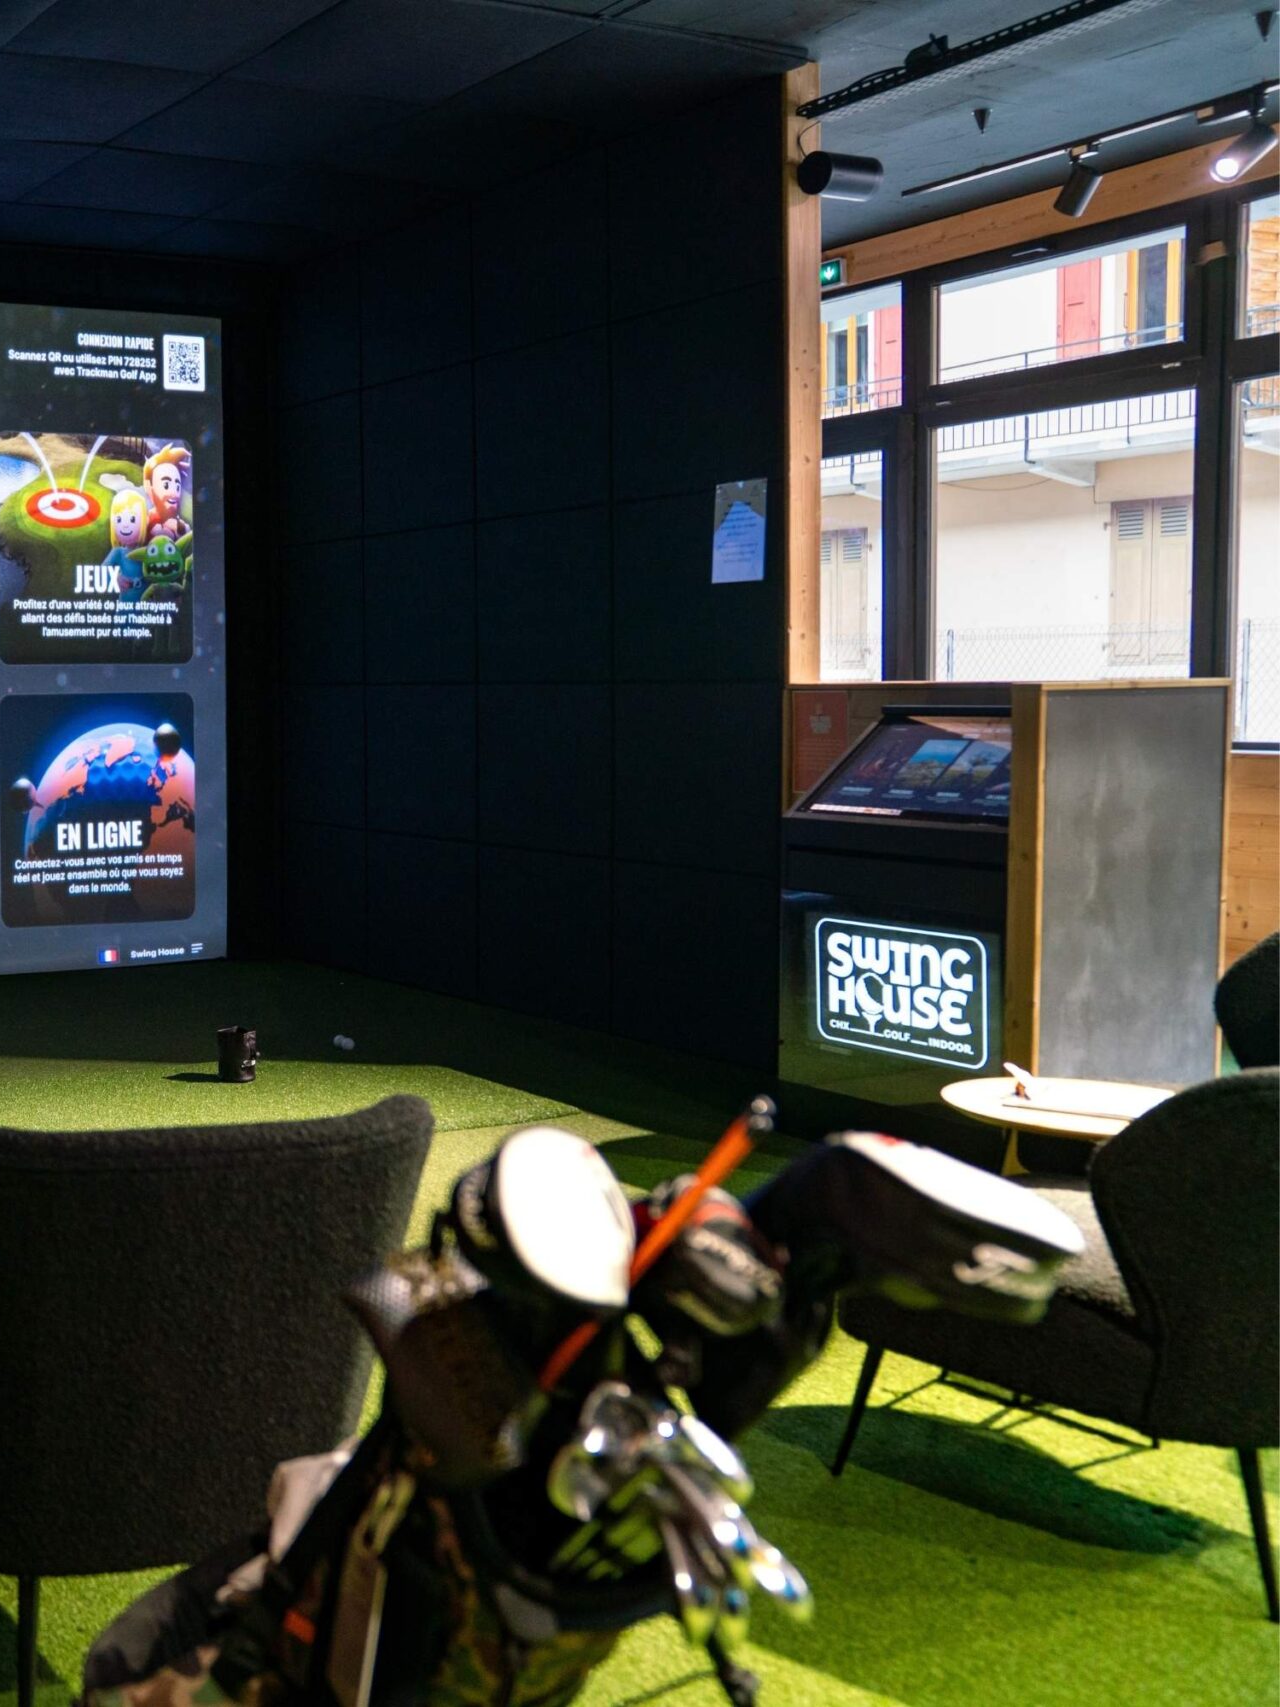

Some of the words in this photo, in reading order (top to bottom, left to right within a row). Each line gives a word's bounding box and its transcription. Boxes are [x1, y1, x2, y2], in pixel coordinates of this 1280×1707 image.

[77, 333, 123, 347] CONNEXION
[125, 336, 154, 350] RAPIDE
[8, 349, 46, 361] Scannez
[48, 351, 61, 362] QR
[63, 354, 75, 363] ou
[76, 353, 106, 365] utilisez
[108, 356, 123, 366] PIN
[54, 367, 75, 376] avec
[76, 366, 118, 379] Trackman
[120, 369, 138, 380] Golf
[139, 371, 157, 383] App
[74, 565, 120, 593] JEUX
[13, 599, 47, 610] Profitez
[49, 599, 71, 610] d'une
[74, 599, 102, 610] variété
[104, 600, 115, 610] de
[116, 601, 133, 612] jeux
[135, 601, 179, 613] attrayants,
[21, 613, 45, 623] allant
[47, 613, 62, 623] des
[64, 613, 85, 623] défis
[87, 613, 111, 624] basés
[113, 615, 126, 624] sur
[128, 613, 165, 624] l'habileté
[166, 615, 172, 624] à
[42, 627, 95, 637] l'amusement
[97, 629, 110, 639] pur
[112, 627, 121, 637] et
[123, 627, 152, 639] simple.
[57, 823, 81, 851] EN
[87, 821, 142, 849] LIGNE
[15, 858, 84, 870] Connectez-vous
[86, 857, 106, 866] avec
[108, 855, 121, 864] vos
[124, 853, 143, 864] amis
[145, 855, 155, 863] en
[157, 854, 182, 865] temps
[13, 873, 30, 883] réel
[31, 873, 41, 882] et
[42, 871, 65, 884] jouez
[67, 869, 107, 880] ensemble
[109, 867, 120, 878] où
[121, 868, 137, 879] que
[139, 867, 158, 877] vous
[160, 867, 183, 879] soyez
[69, 883, 89, 894] dans
[91, 882, 99, 893] le
[101, 881, 131, 892] monde.
[130, 949, 157, 959] Swing
[158, 947, 185, 956] House
[827, 932, 974, 992] SWING
[828, 972, 972, 1036] HOUSE
[883, 1029, 911, 1042] GOLF
